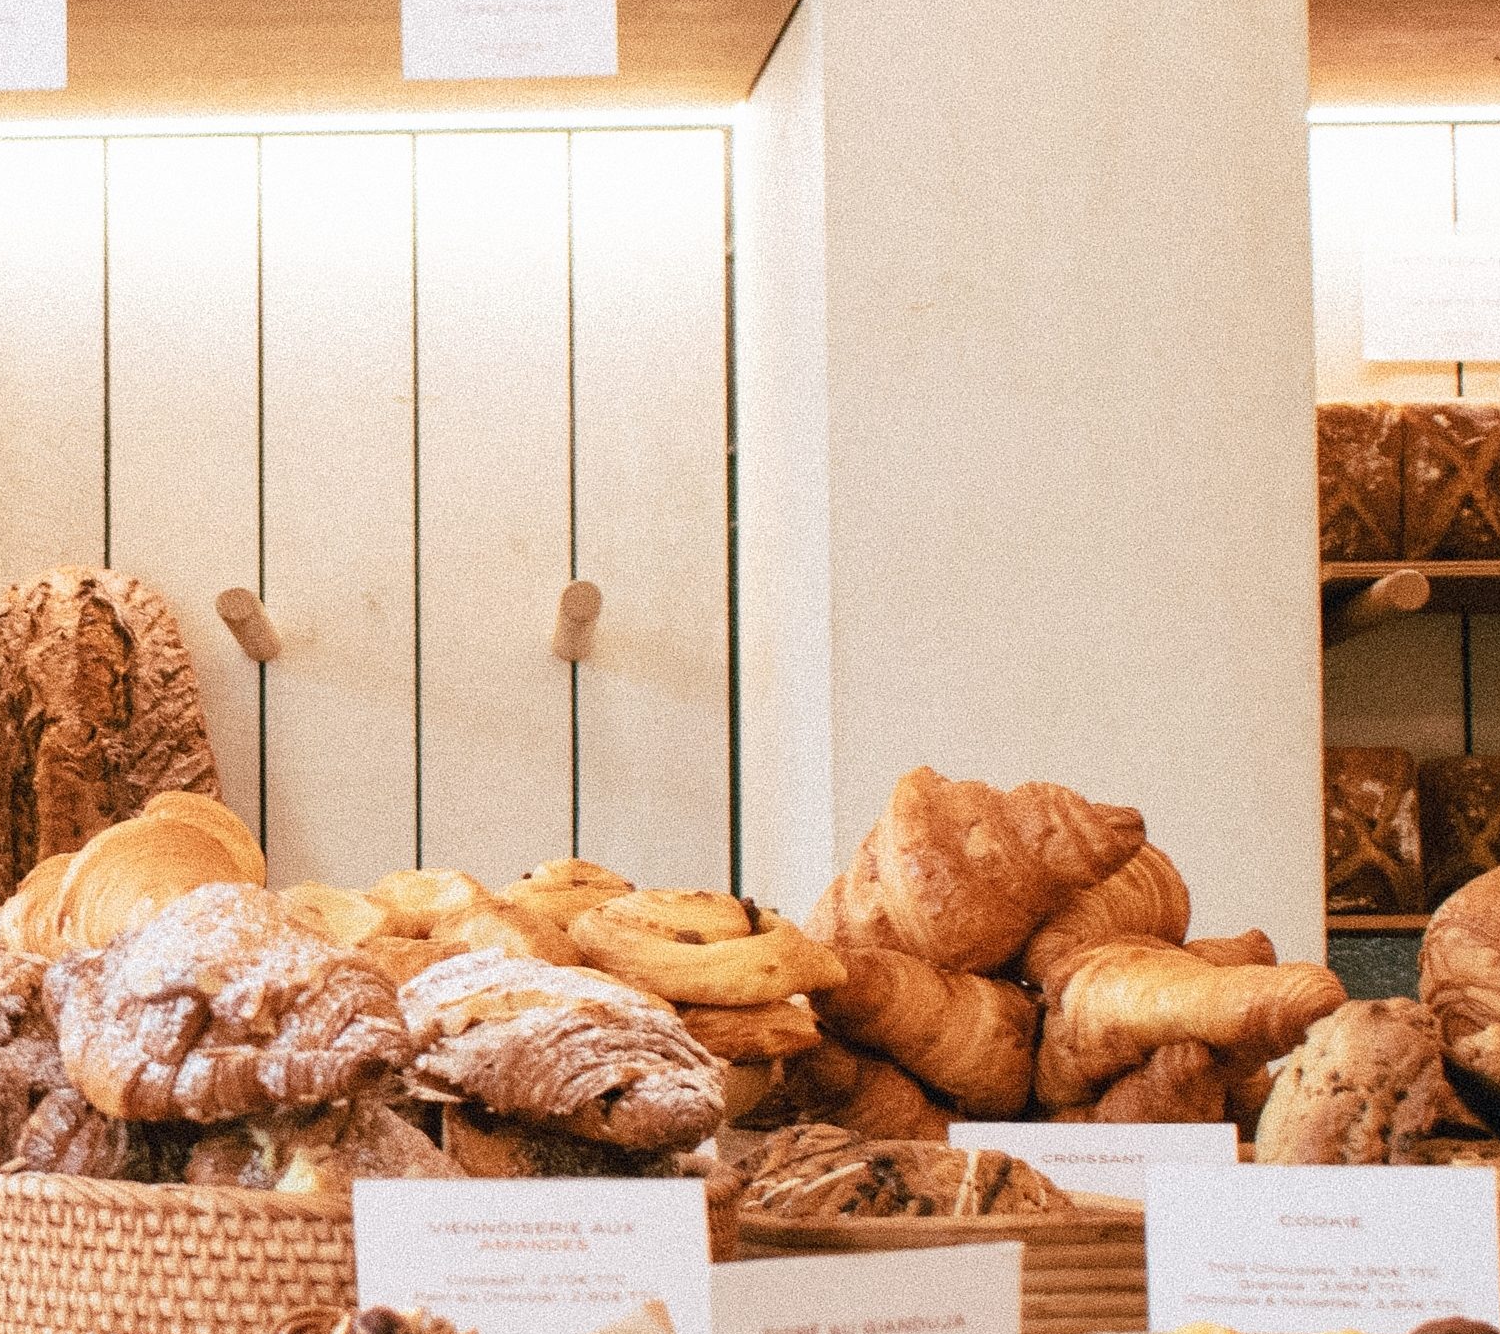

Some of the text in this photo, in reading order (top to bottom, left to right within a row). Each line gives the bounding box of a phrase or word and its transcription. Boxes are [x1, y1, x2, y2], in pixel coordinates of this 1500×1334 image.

[1040, 1152, 1145, 1165] CROISSANT
[427, 1221, 635, 1236] VIENNOISERIE AUX
[1278, 1215, 1363, 1229] COOKIE
[478, 1237, 589, 1253] AMANDES
